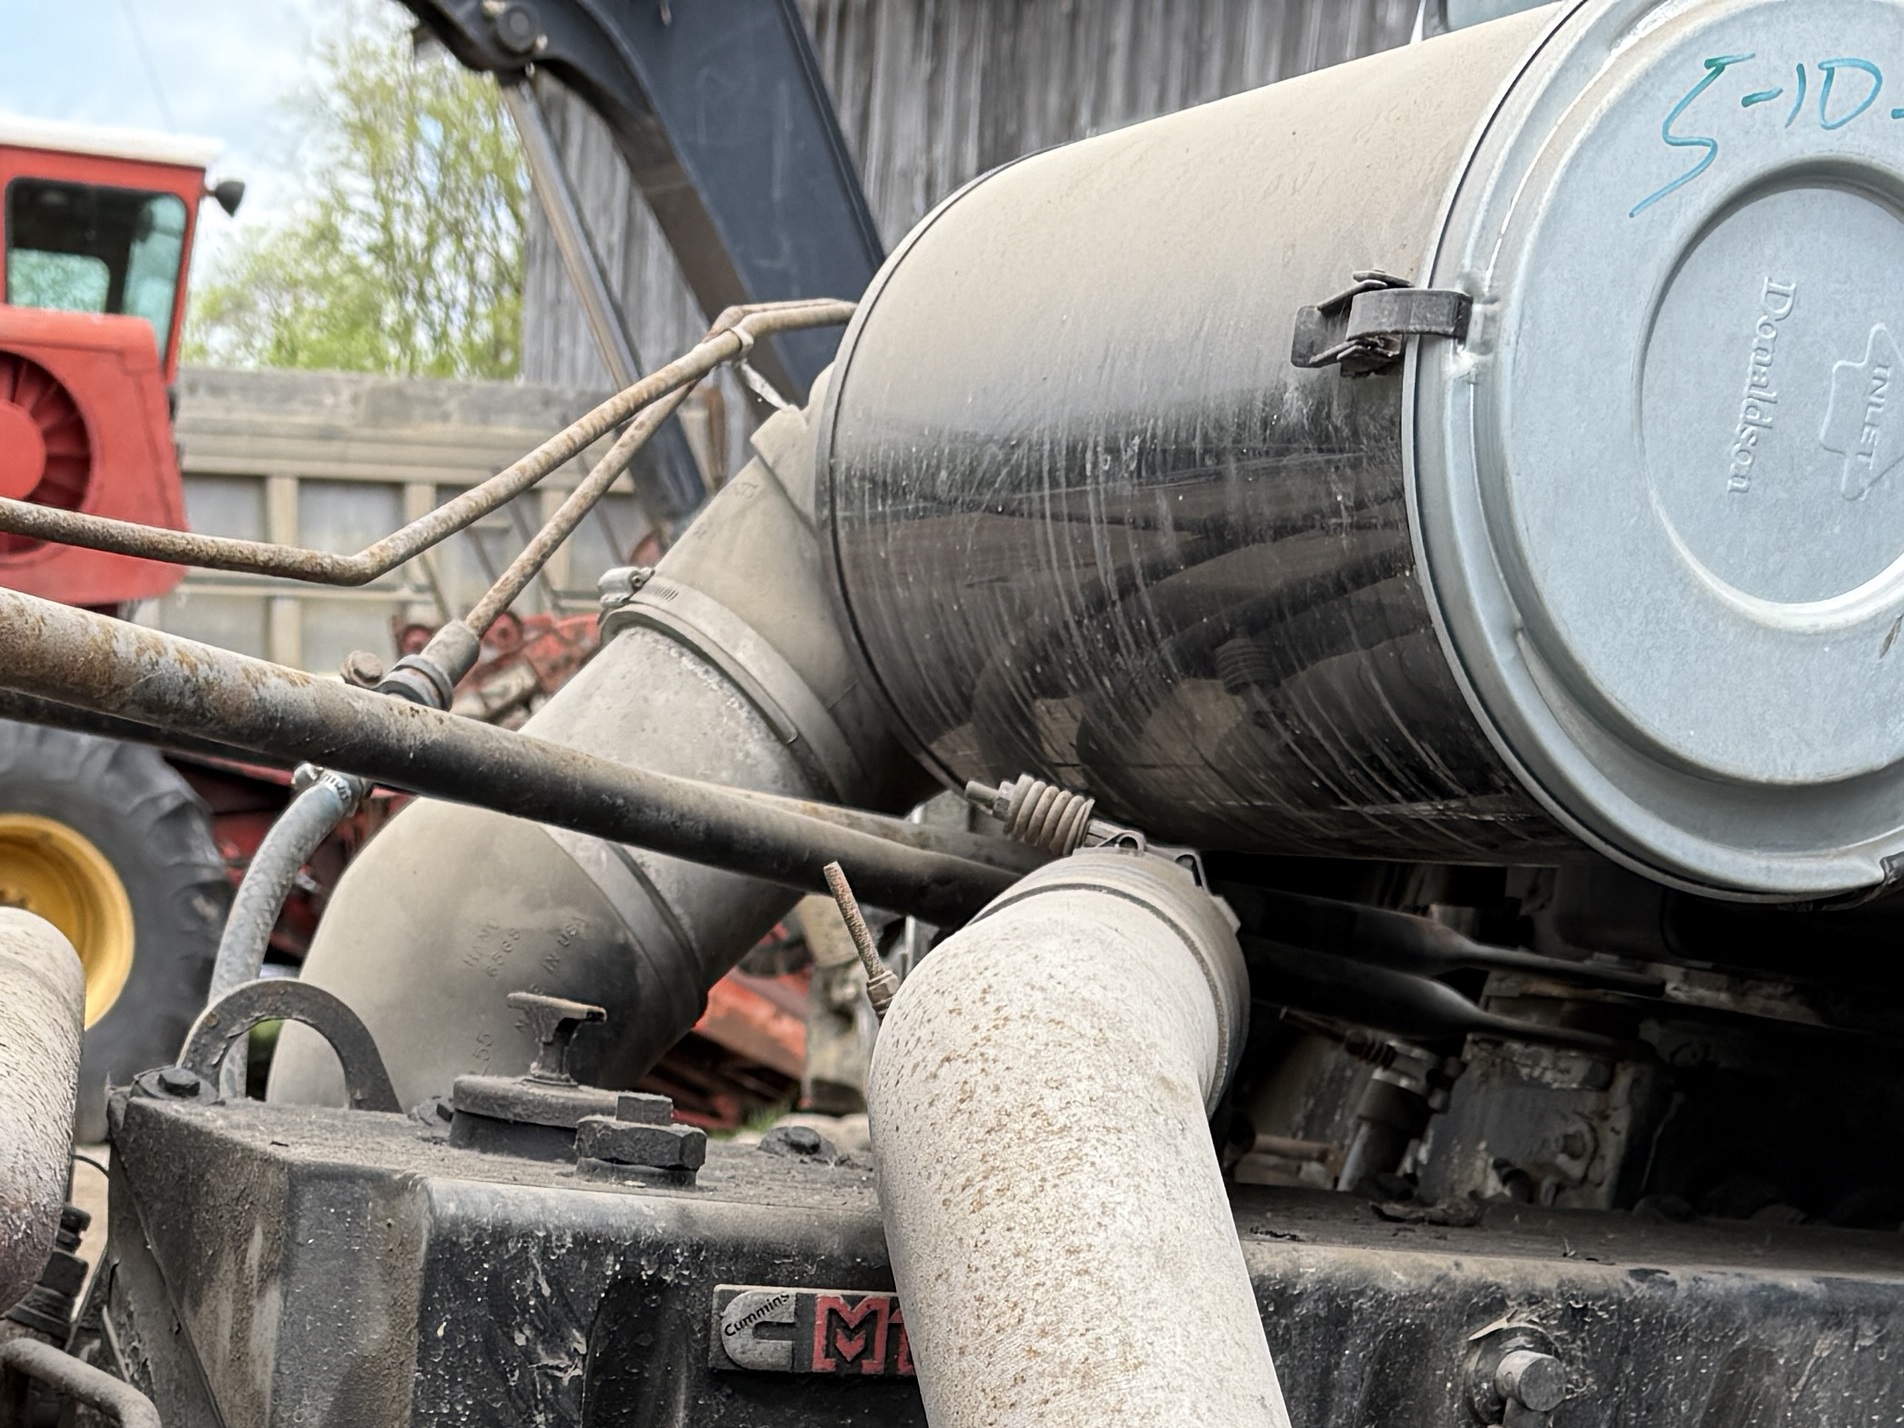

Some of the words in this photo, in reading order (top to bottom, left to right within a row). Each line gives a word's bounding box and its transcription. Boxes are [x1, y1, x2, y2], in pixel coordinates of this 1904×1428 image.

[1725, 275, 1799, 497] Donaldson
[1859, 362, 1894, 472] INLET
[724, 1291, 790, 1338] Cummins
